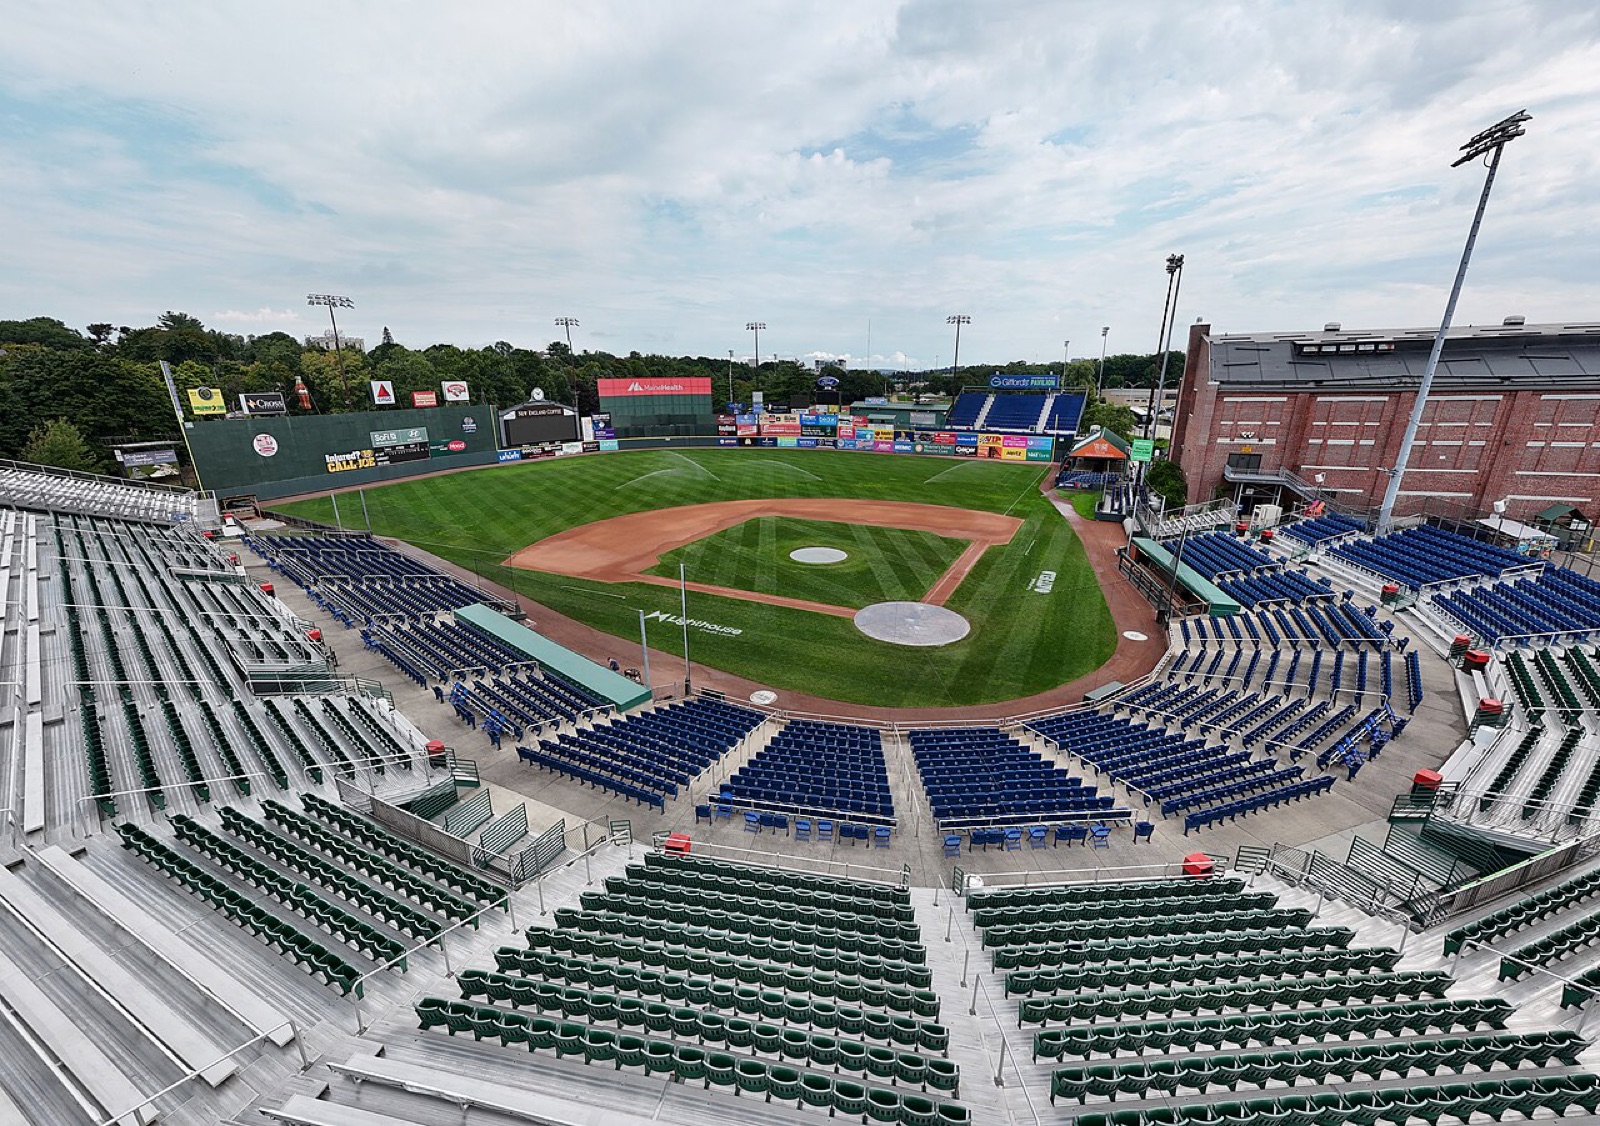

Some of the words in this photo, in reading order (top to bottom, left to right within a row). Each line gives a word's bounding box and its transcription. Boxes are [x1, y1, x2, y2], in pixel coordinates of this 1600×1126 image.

[325, 451, 361, 464] Injured?
[327, 459, 357, 473] CALL
[358, 456, 376, 469] JOE
[667, 615, 743, 635] Lighthouse
